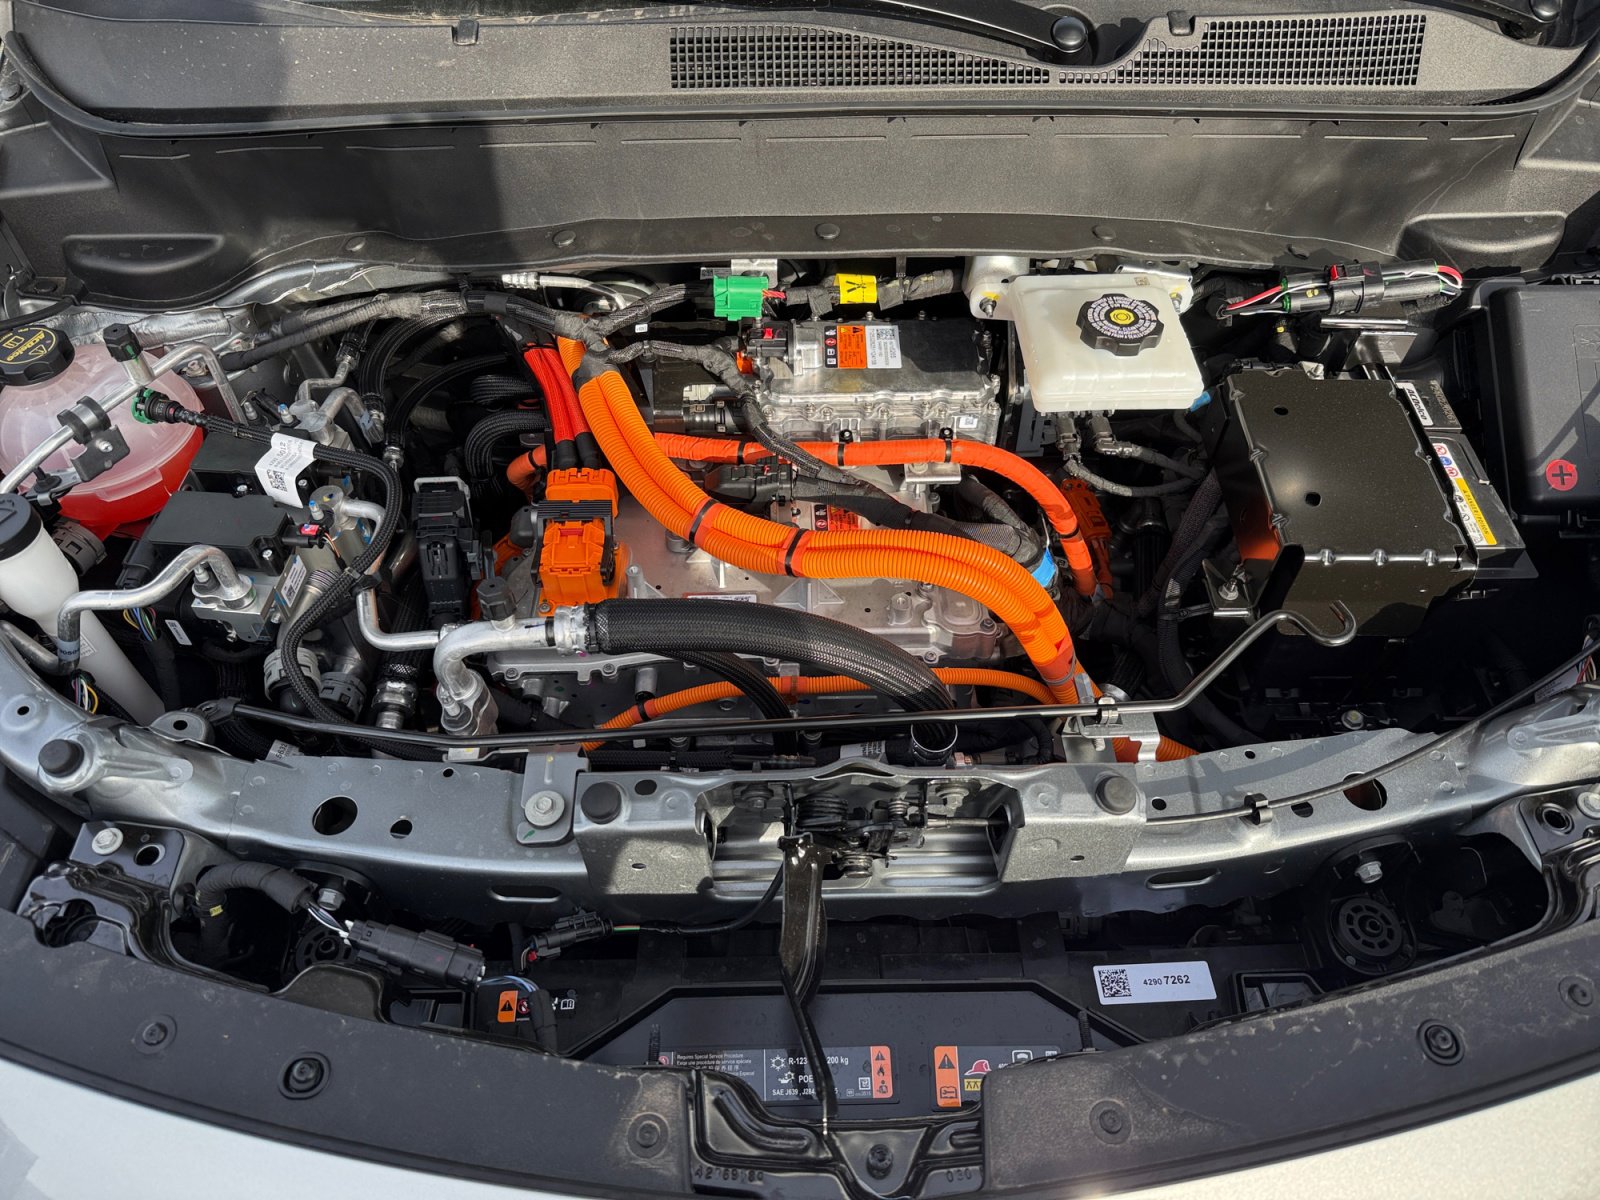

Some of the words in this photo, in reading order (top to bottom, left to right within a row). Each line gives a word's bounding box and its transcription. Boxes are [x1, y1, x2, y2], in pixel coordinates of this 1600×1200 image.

[7, 331, 45, 361] ACDelco
[1406, 388, 1428, 420] ACDelco
[788, 1057, 808, 1065] R-123
[840, 1056, 849, 1065] kg
[798, 1075, 814, 1083] POE
